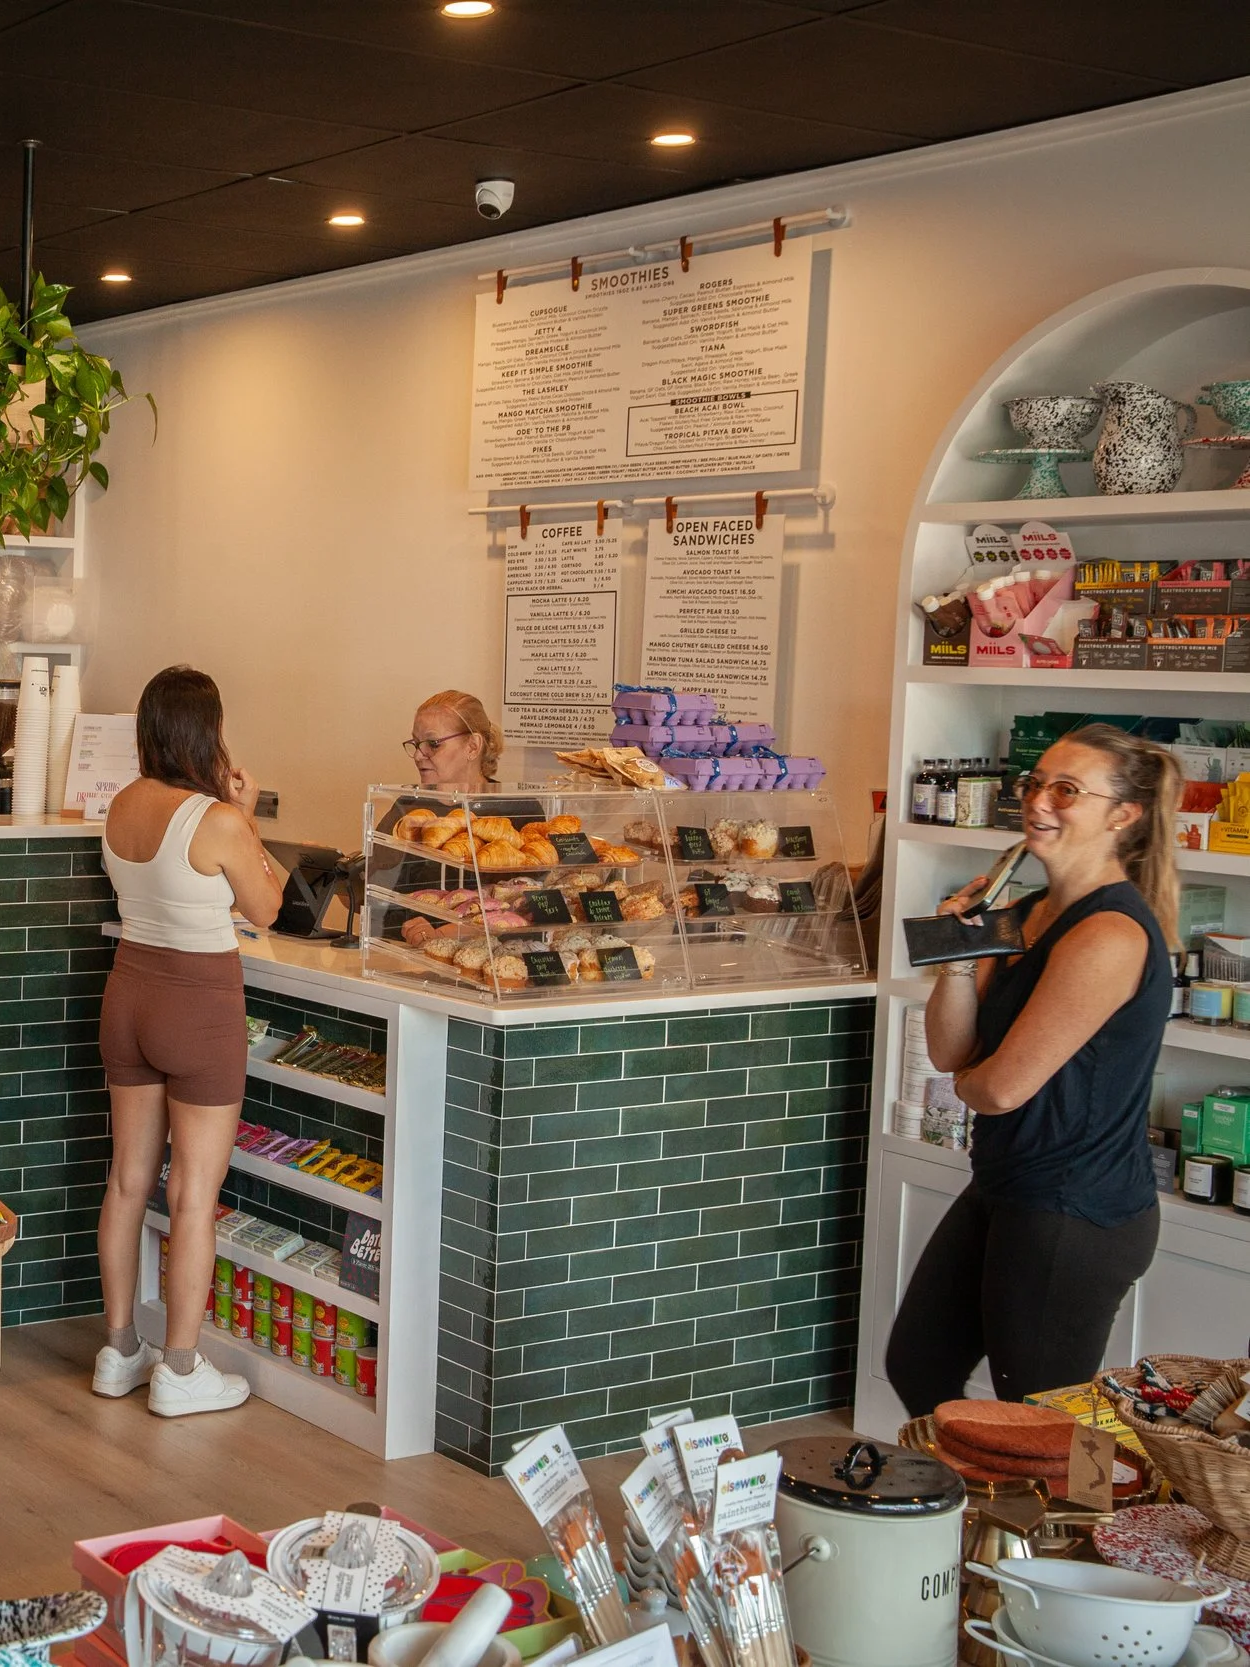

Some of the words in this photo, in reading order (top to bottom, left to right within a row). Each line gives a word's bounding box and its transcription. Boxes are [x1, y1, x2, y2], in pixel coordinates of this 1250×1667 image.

[590, 266, 670, 292] SMOOTHIES
[700, 279, 733, 290] ROGERS
[530, 305, 568, 317] CUPSOGUE
[663, 306, 688, 316] SUPER
[691, 301, 723, 312] GREENS
[727, 294, 770, 306] SMOOTHIE
[534, 327, 556, 336] JETTY
[690, 320, 739, 333] SWORDFISH
[525, 344, 569, 356] DREAMSICLE
[700, 343, 726, 352] TIANA
[502, 369, 518, 378] KEEP
[521, 368, 527, 376] IT
[529, 366, 553, 375] SIMPLE
[556, 360, 593, 371] SMOOTHIE
[662, 375, 687, 386] BLACK
[691, 373, 716, 383] MAGIC
[720, 368, 763, 379] SMOOTHIE
[538, 384, 569, 394] LASHLEY
[675, 395, 715, 405] SMOOTHIE
[718, 393, 747, 401] BOWLS
[498, 409, 523, 418] MANGO
[525, 406, 553, 415] MATCHA
[556, 403, 593, 412] SMOOTHIE
[675, 406, 699, 414] BEACH
[723, 402, 745, 410] BOWL
[665, 430, 700, 439] TROPICAL
[703, 428, 729, 436] PITAYA
[732, 426, 754, 434] BOWL
[676, 522, 708, 532] OPEN
[713, 520, 753, 532] FACED
[542, 526, 582, 539] COFFEE
[673, 534, 755, 546] SANDWICHES
[361, 1229, 381, 1248] DAT
[717, 1499, 771, 1524] paintbrushes
